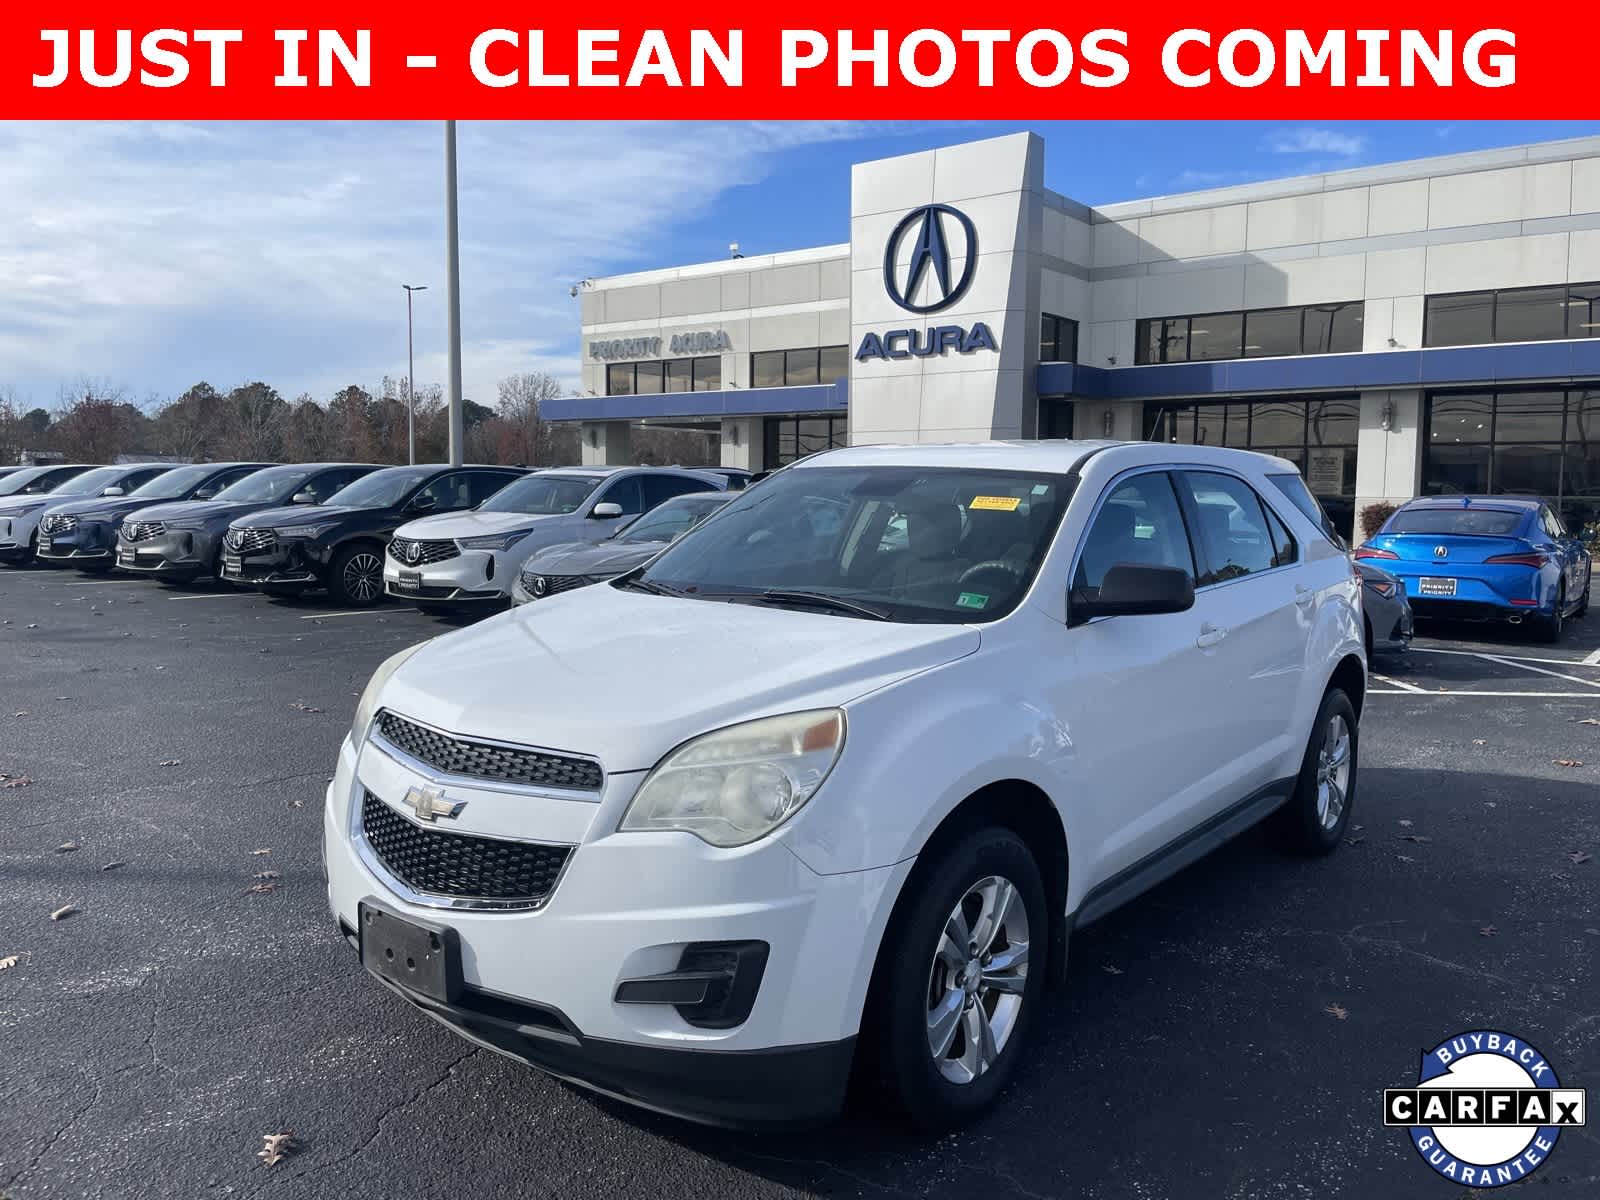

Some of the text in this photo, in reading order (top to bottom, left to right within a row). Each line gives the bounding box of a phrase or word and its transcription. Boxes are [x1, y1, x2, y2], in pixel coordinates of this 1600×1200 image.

[589, 330, 732, 359] PRIORITY ACURA
[855, 322, 997, 360] ACURA
